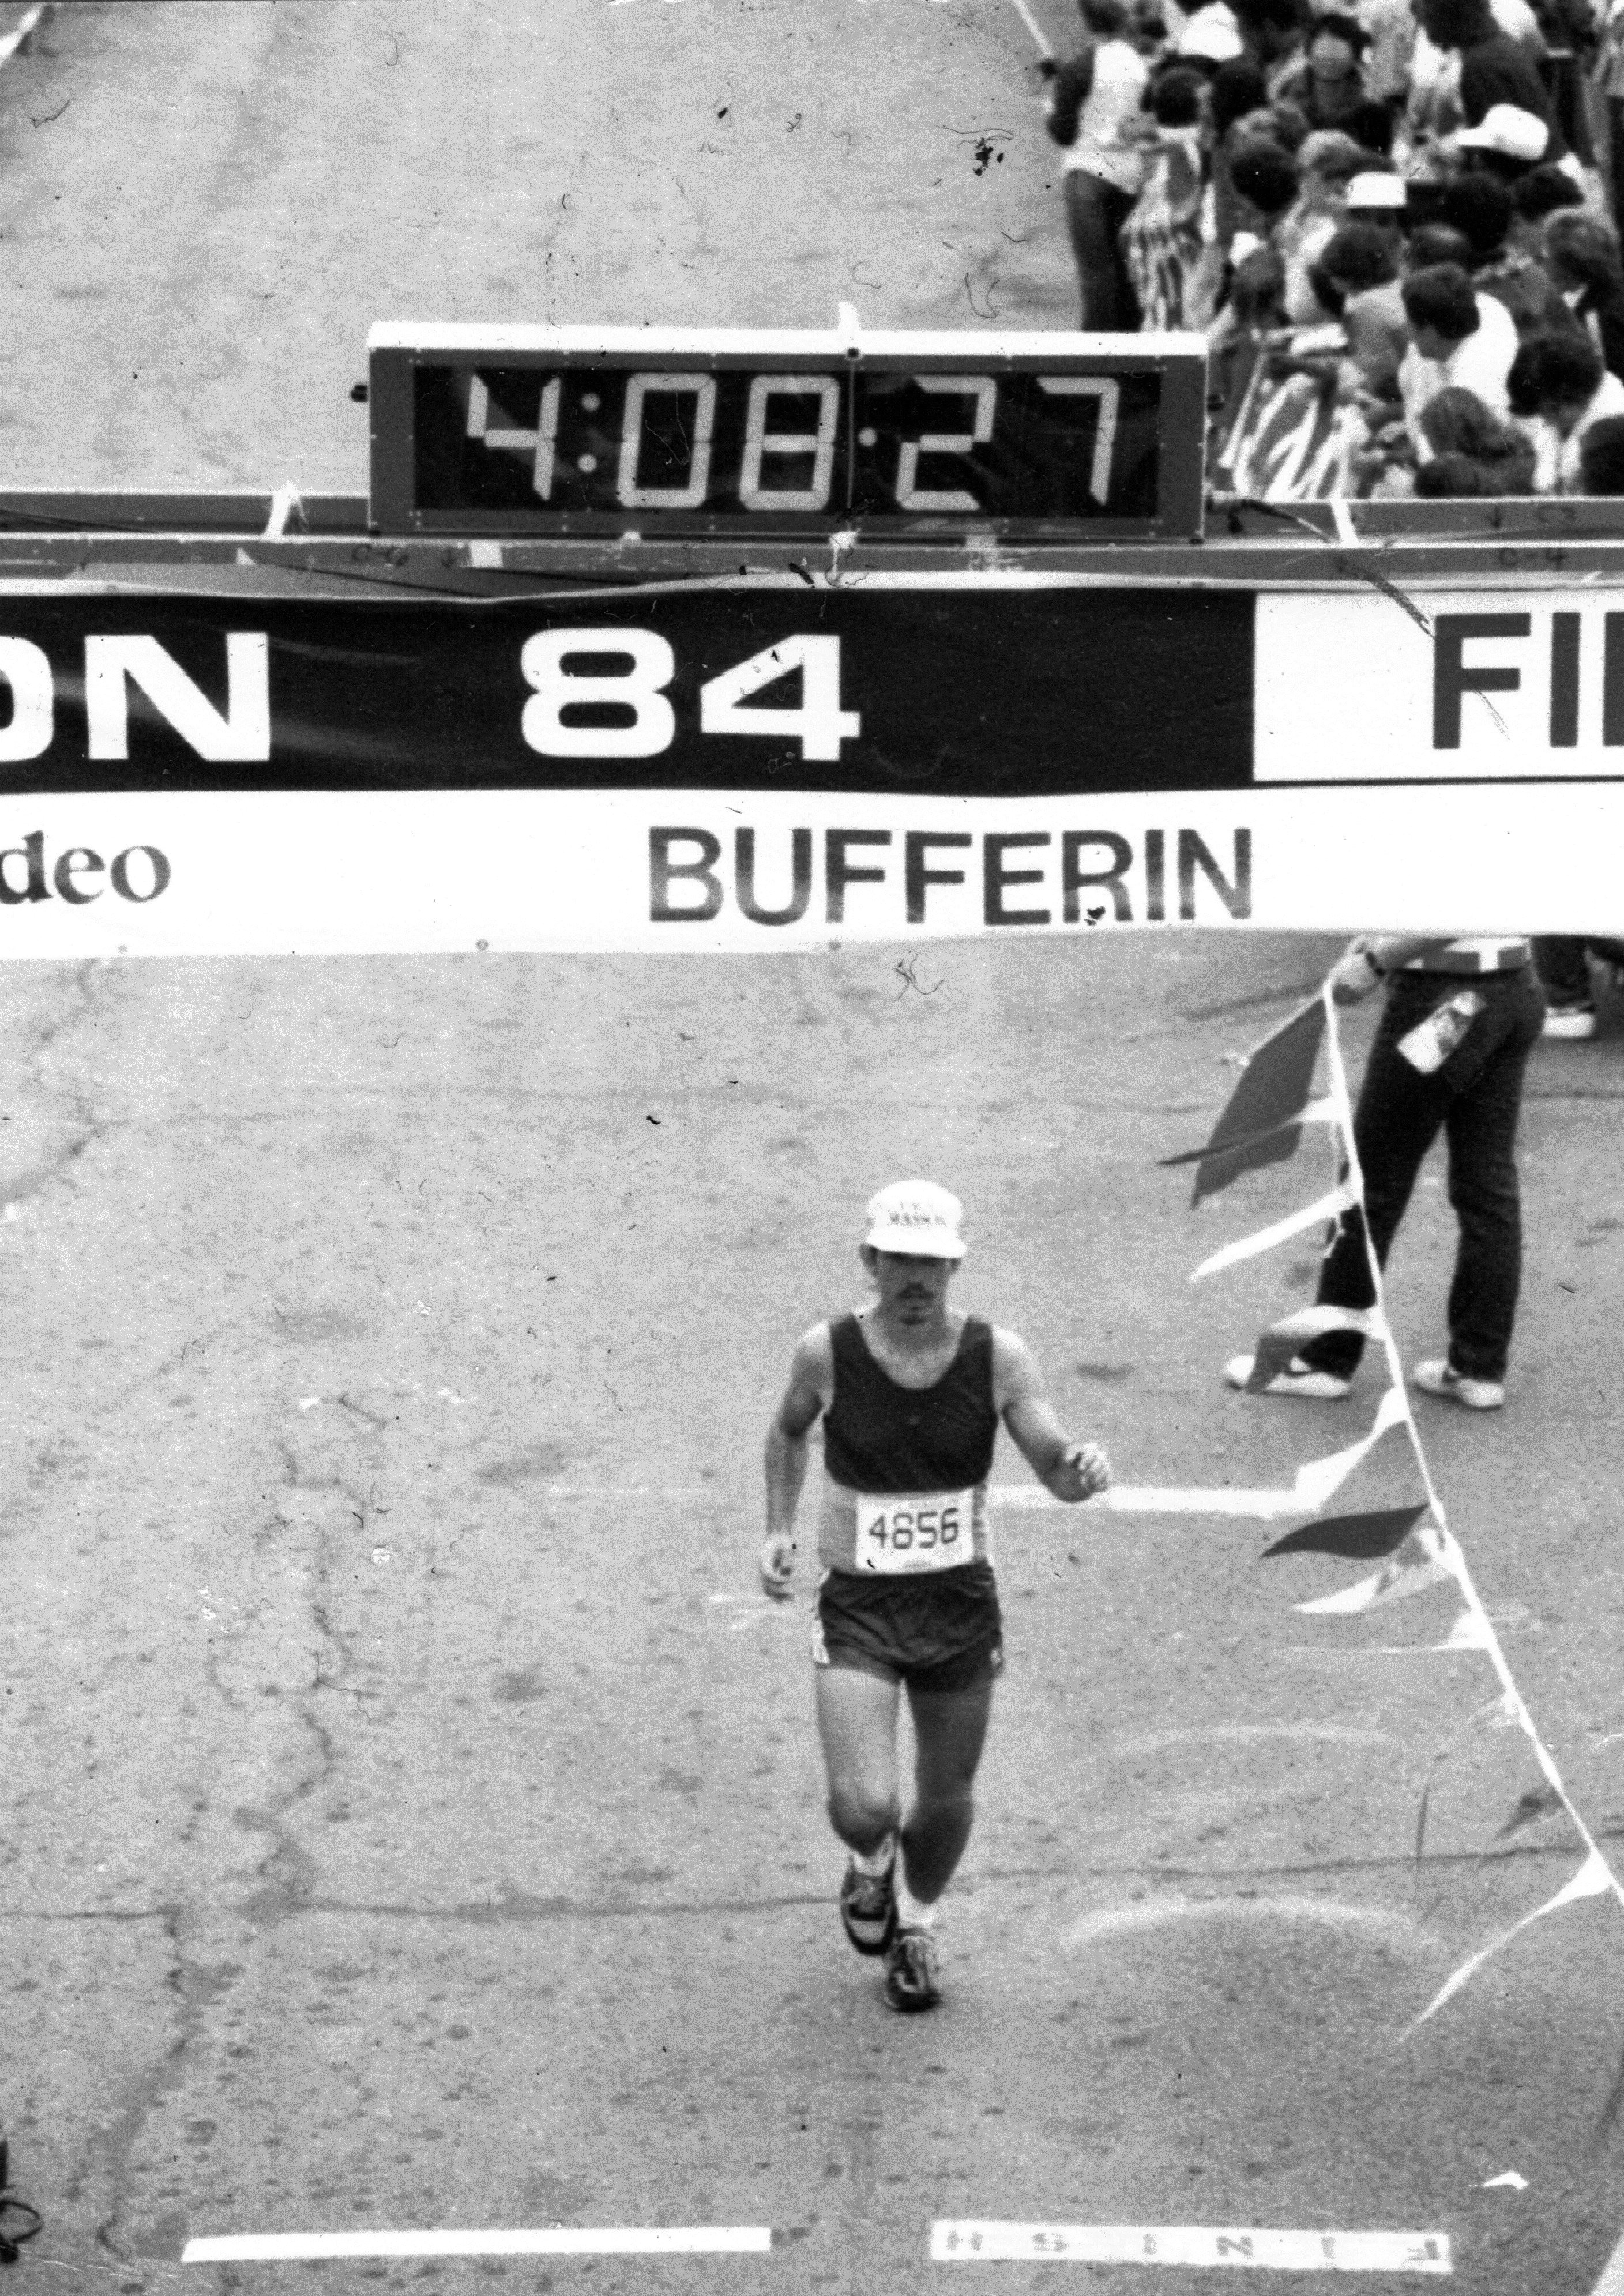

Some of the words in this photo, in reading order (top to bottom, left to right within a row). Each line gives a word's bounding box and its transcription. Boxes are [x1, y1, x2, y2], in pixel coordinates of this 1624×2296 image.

[521, 628, 860, 761] 84
[1433, 612, 1624, 750] FI
[648, 826, 1252, 927] BUFFERIN
[869, 1507, 959, 1550] 4856
